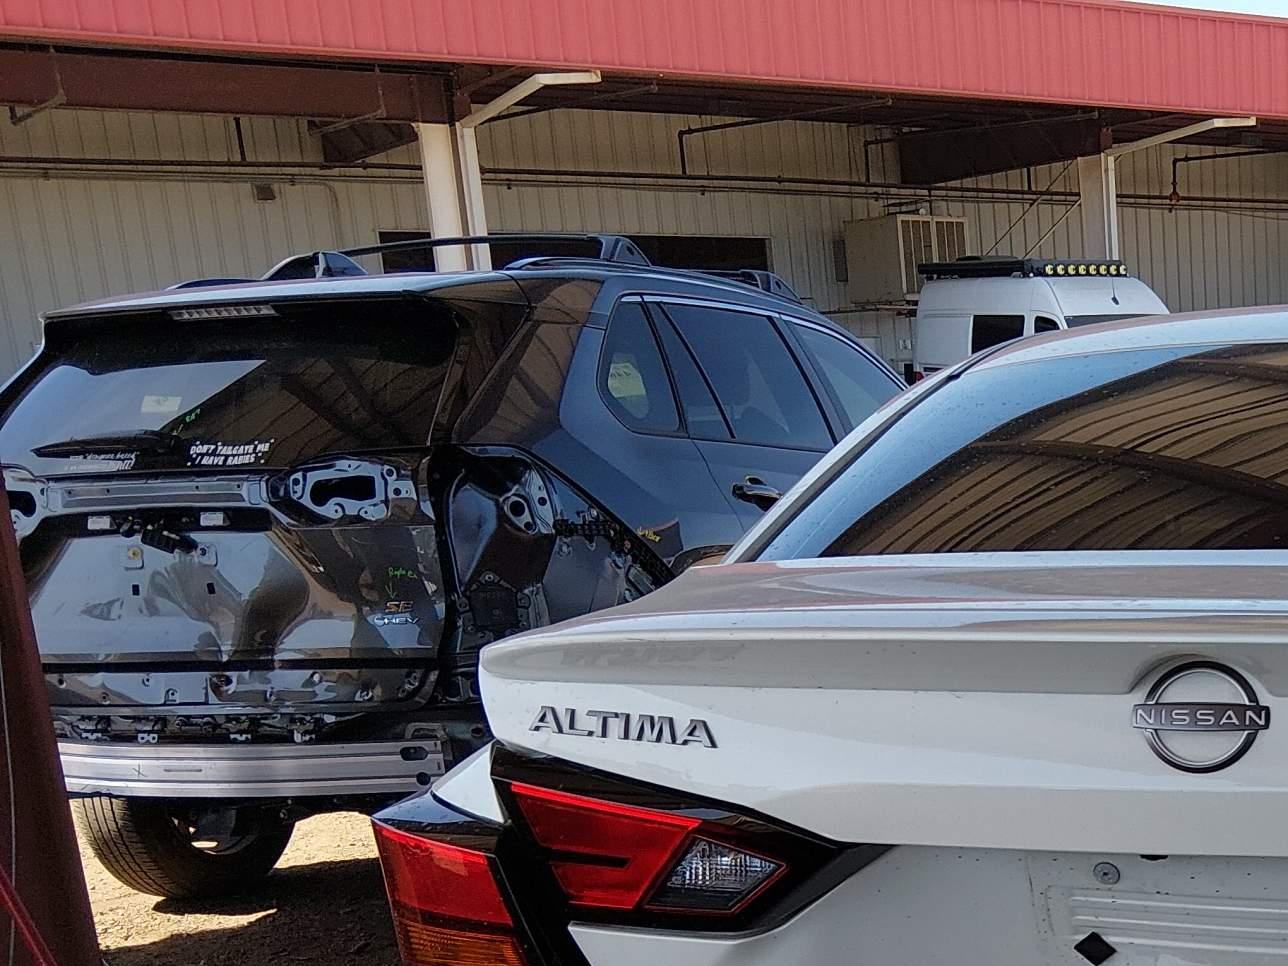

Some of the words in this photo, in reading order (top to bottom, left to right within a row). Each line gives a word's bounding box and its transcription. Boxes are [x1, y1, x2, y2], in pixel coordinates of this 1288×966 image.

[190, 444, 216, 454] DON'T
[216, 444, 254, 455] TAILGATE
[256, 443, 270, 452] ME
[201, 456, 225, 465] HAVE
[226, 454, 256, 465] RABIES
[384, 601, 413, 612] SE
[1135, 708, 1266, 726] NISSAN
[528, 705, 719, 749] ALTIMA
